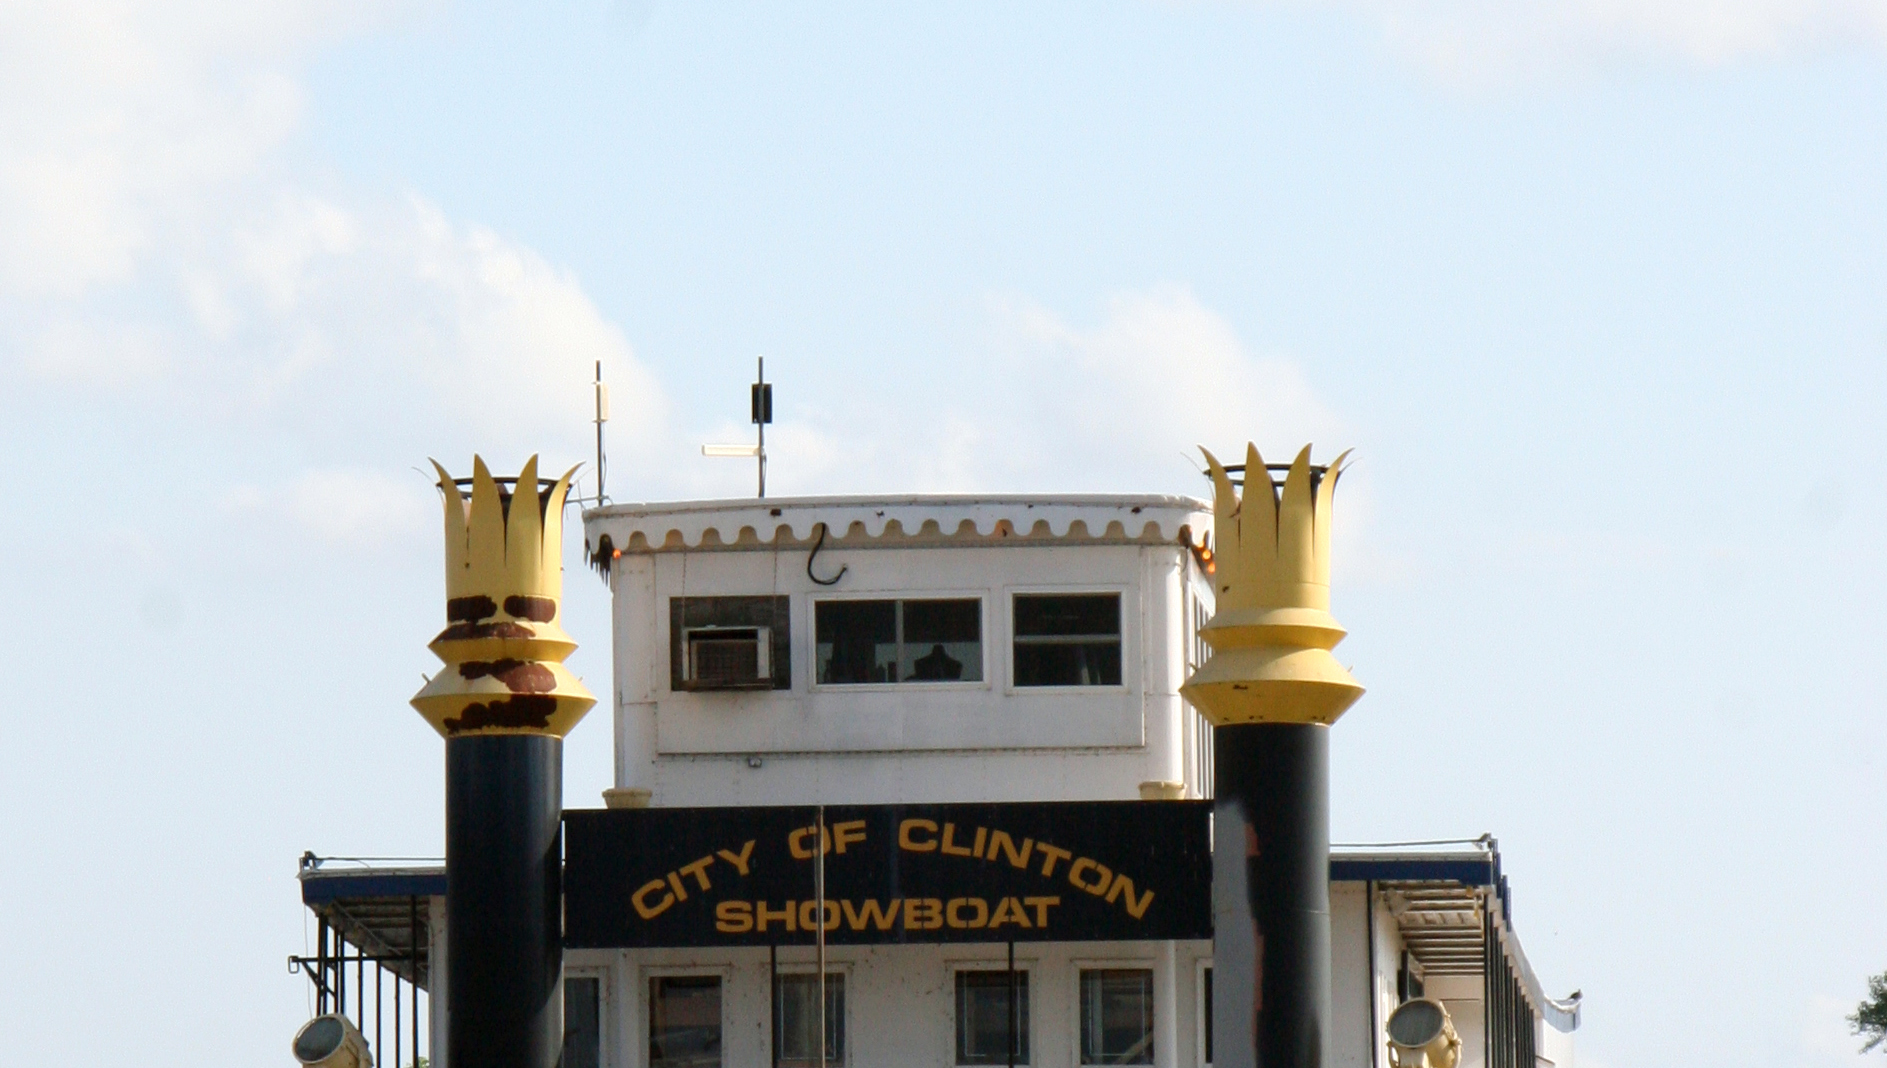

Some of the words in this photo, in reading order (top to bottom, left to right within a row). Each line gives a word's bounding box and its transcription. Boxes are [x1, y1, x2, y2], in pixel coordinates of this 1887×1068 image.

[631, 840, 756, 920] CITY
[788, 819, 867, 859] OF
[898, 818, 1155, 920] CLINTON
[715, 896, 1060, 934] SHOWBOAT
